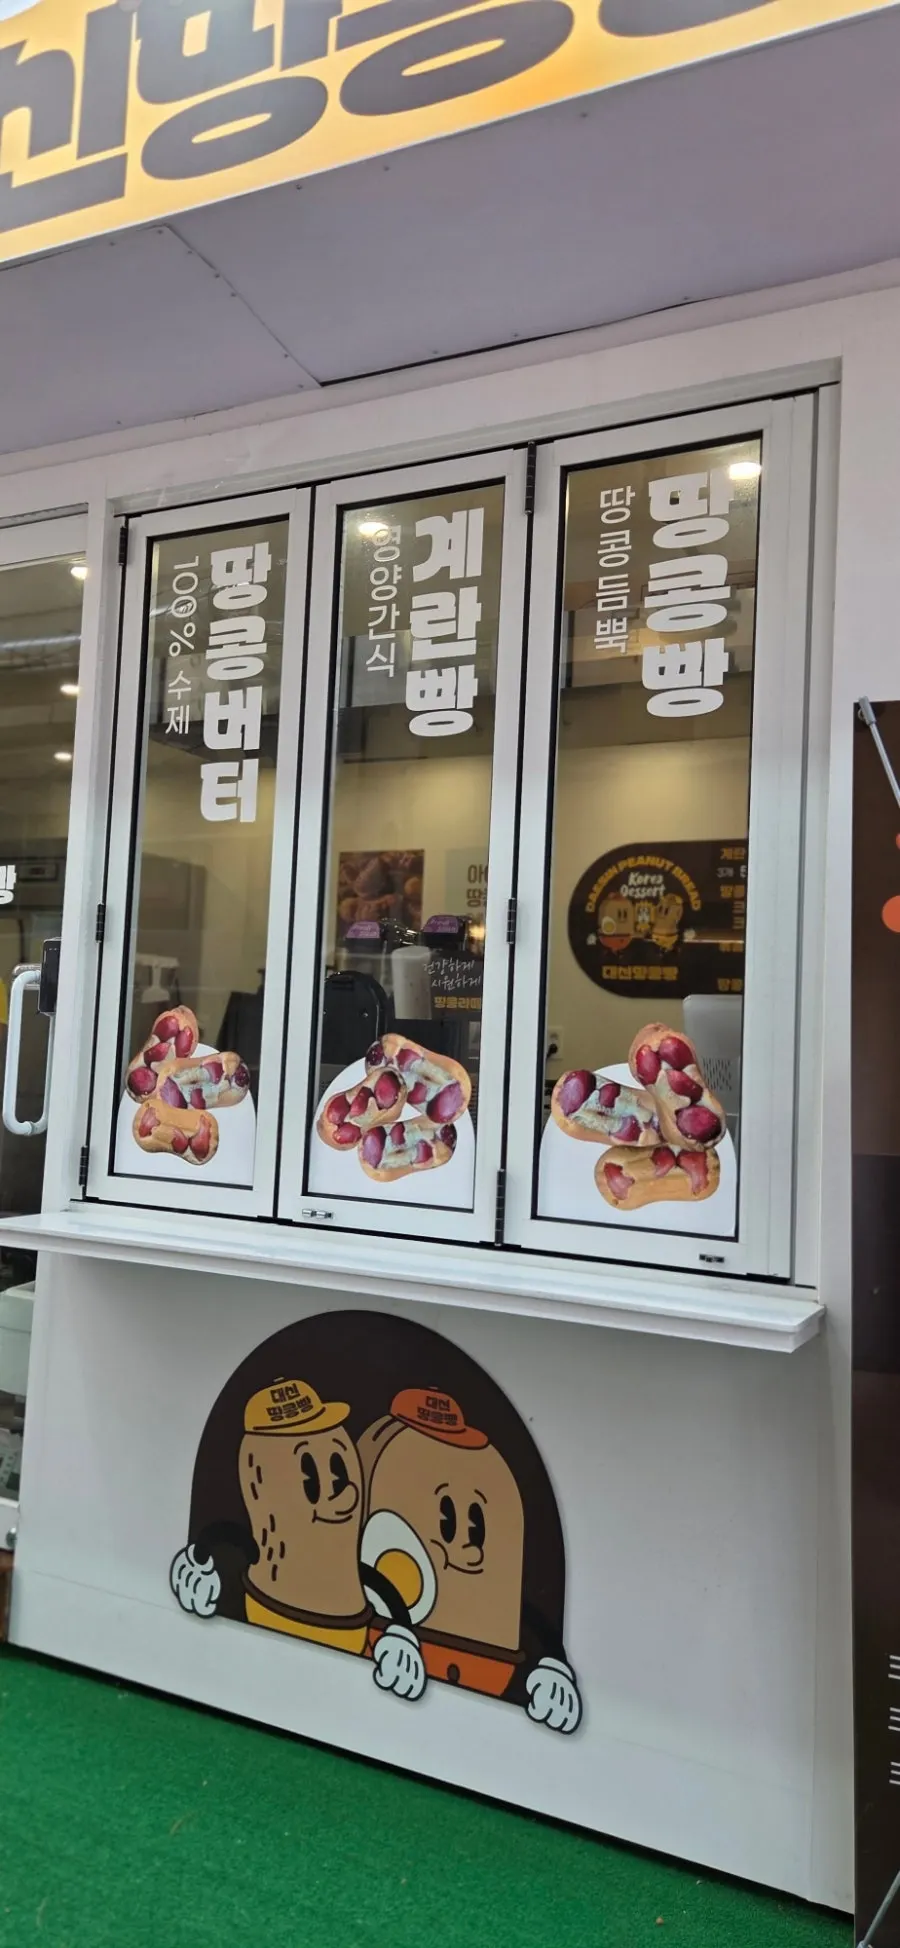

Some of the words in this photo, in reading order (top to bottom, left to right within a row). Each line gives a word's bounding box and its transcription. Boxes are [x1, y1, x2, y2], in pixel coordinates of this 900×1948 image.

[365, 525, 402, 678] 영양간식
[642, 468, 736, 718] 땅콩빵
[168, 555, 199, 658] 100%
[405, 507, 485, 737] 계란빵
[200, 541, 272, 823] 땅콩버터
[165, 670, 192, 735] 수제
[618, 856, 674, 872] PEANUT
[628, 871, 664, 886] Korea
[619, 884, 666, 899] Dessert
[423, 957, 475, 975] 건강하게
[431, 973, 481, 991] 시원하게
[270, 1383, 301, 1404] 대신
[425, 1396, 451, 1412] 대신
[266, 1395, 314, 1422] 땅콩빵
